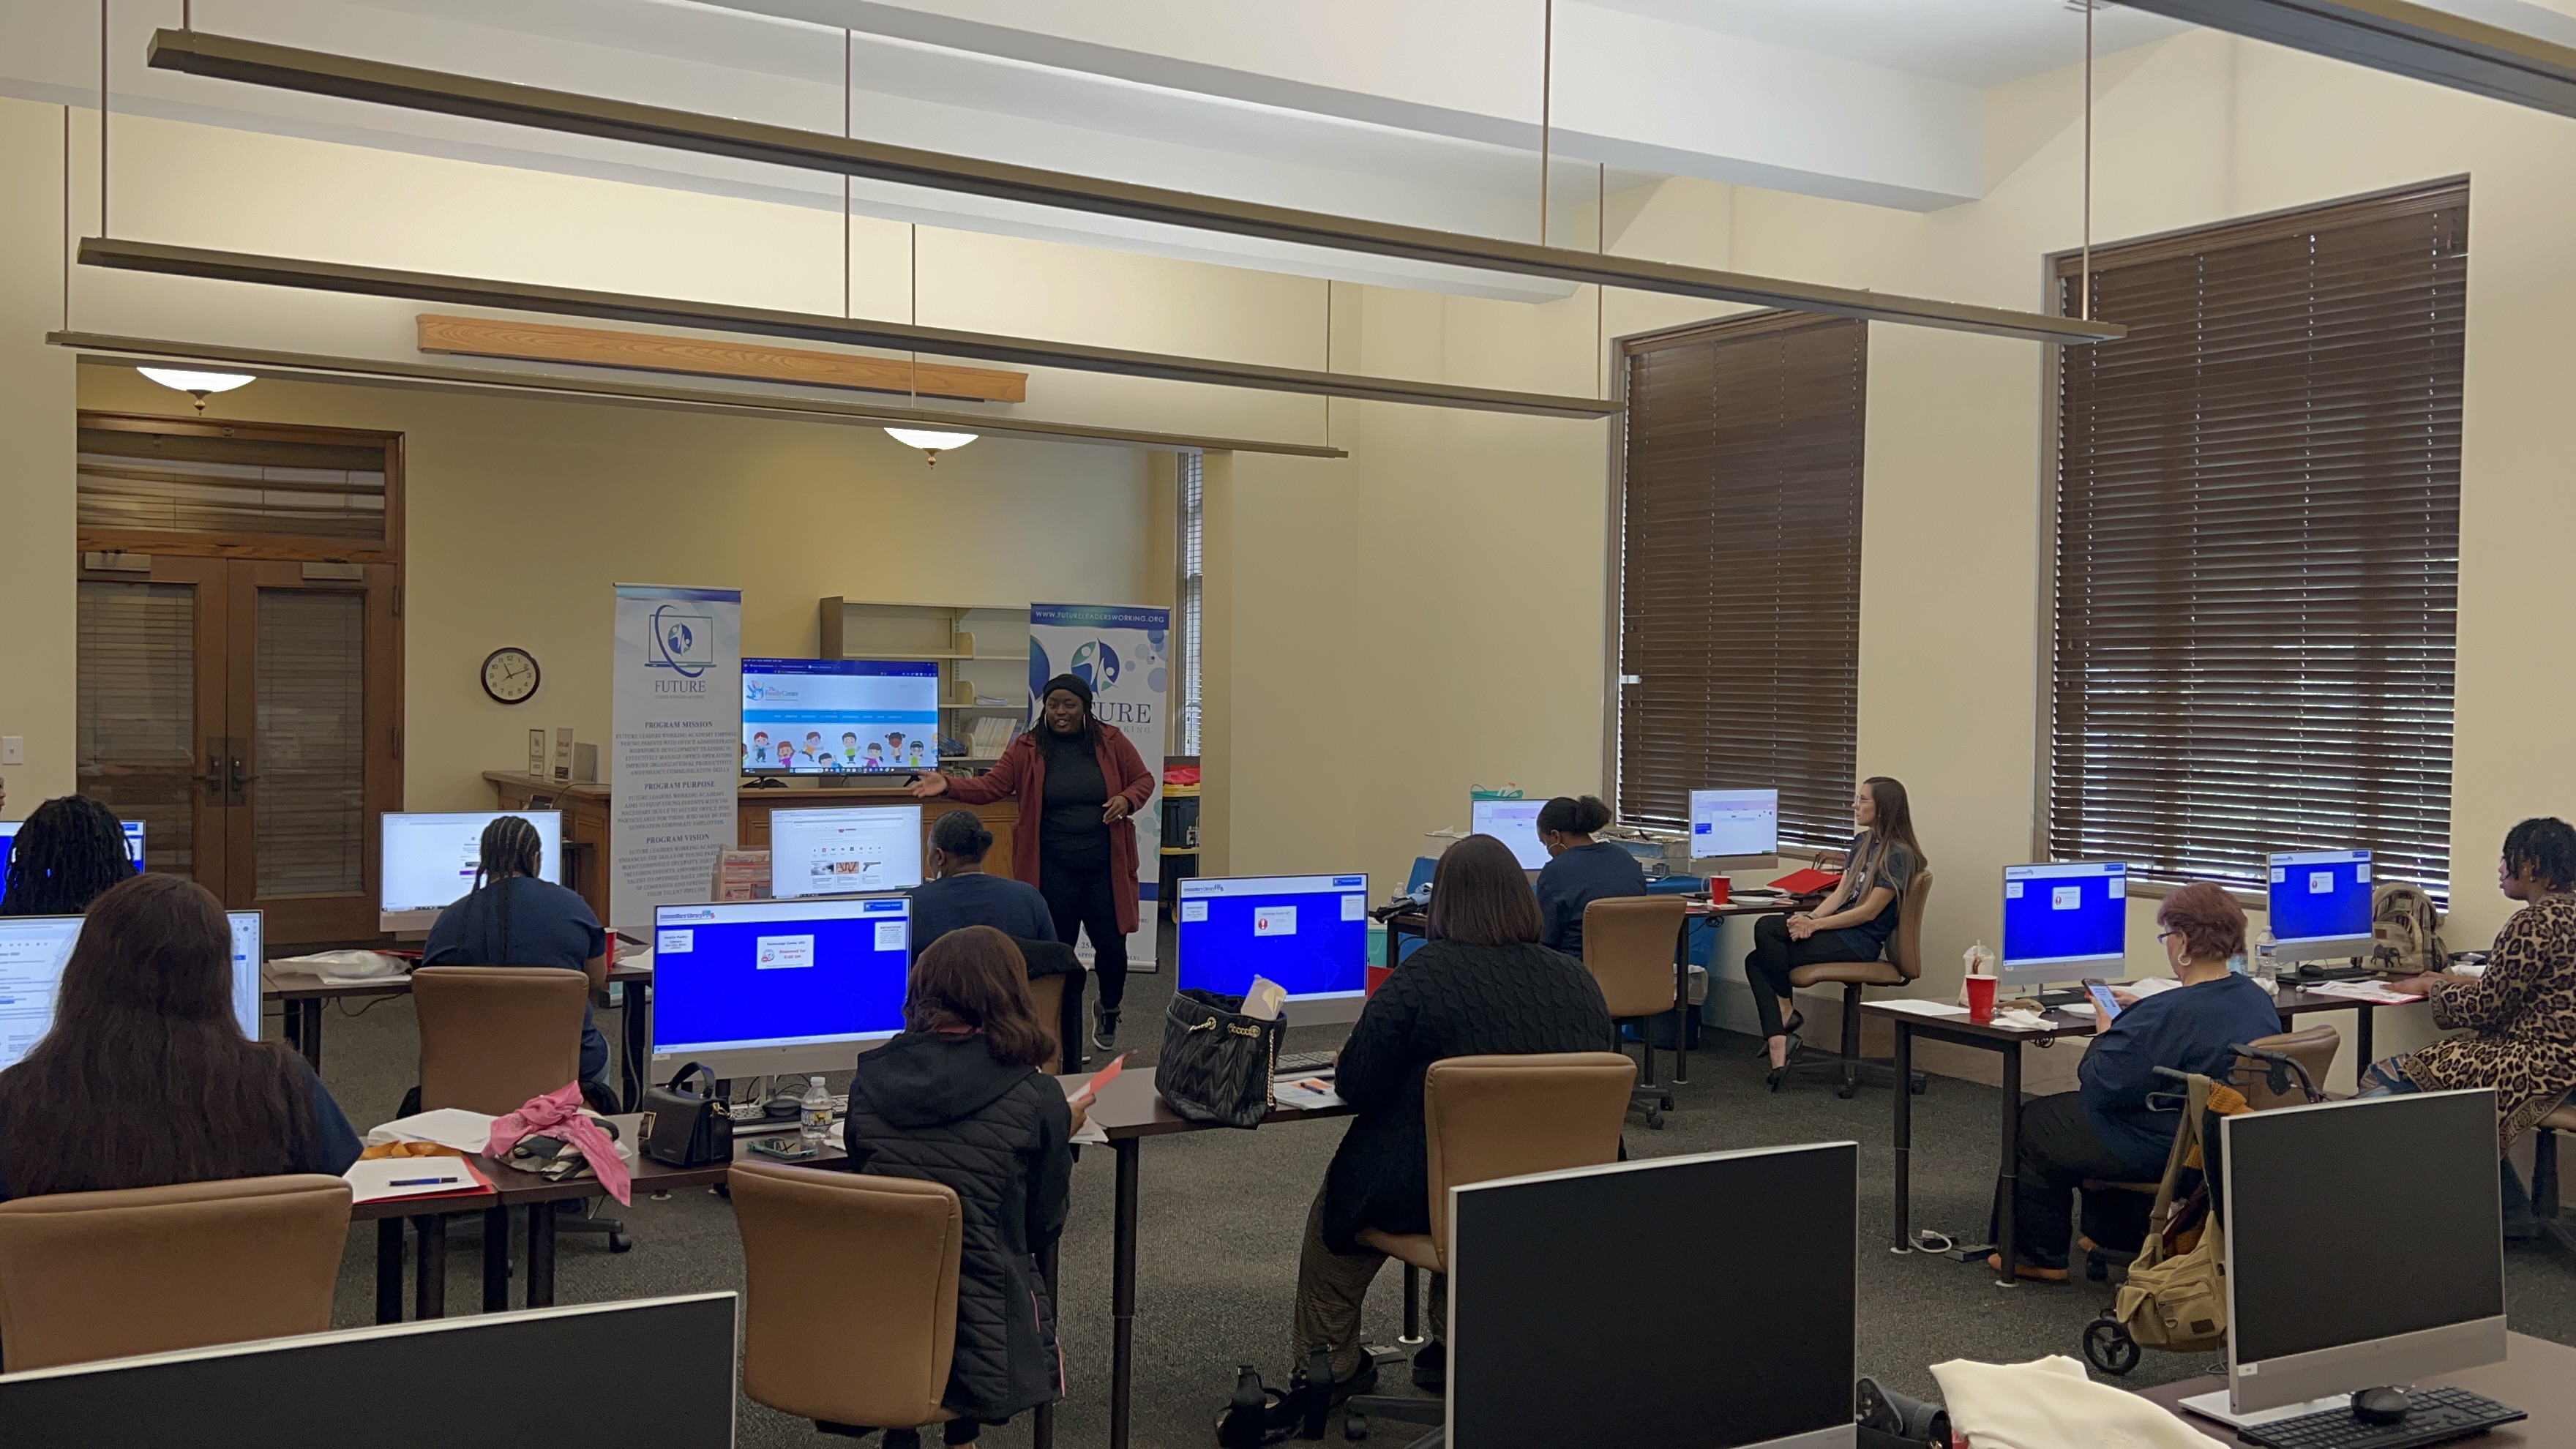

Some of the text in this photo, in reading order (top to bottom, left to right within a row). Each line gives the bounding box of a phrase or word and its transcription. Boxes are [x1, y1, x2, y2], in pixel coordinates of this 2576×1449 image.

[1036, 611, 1164, 623] WWW.FUTURELEADERSWORKING.ORG
[655, 680, 705, 692] FUTURE
[1092, 702, 1151, 724] URE
[645, 781, 715, 790] PROGRAM PURPOSE
[646, 834, 710, 844] PROGRAM VISION
